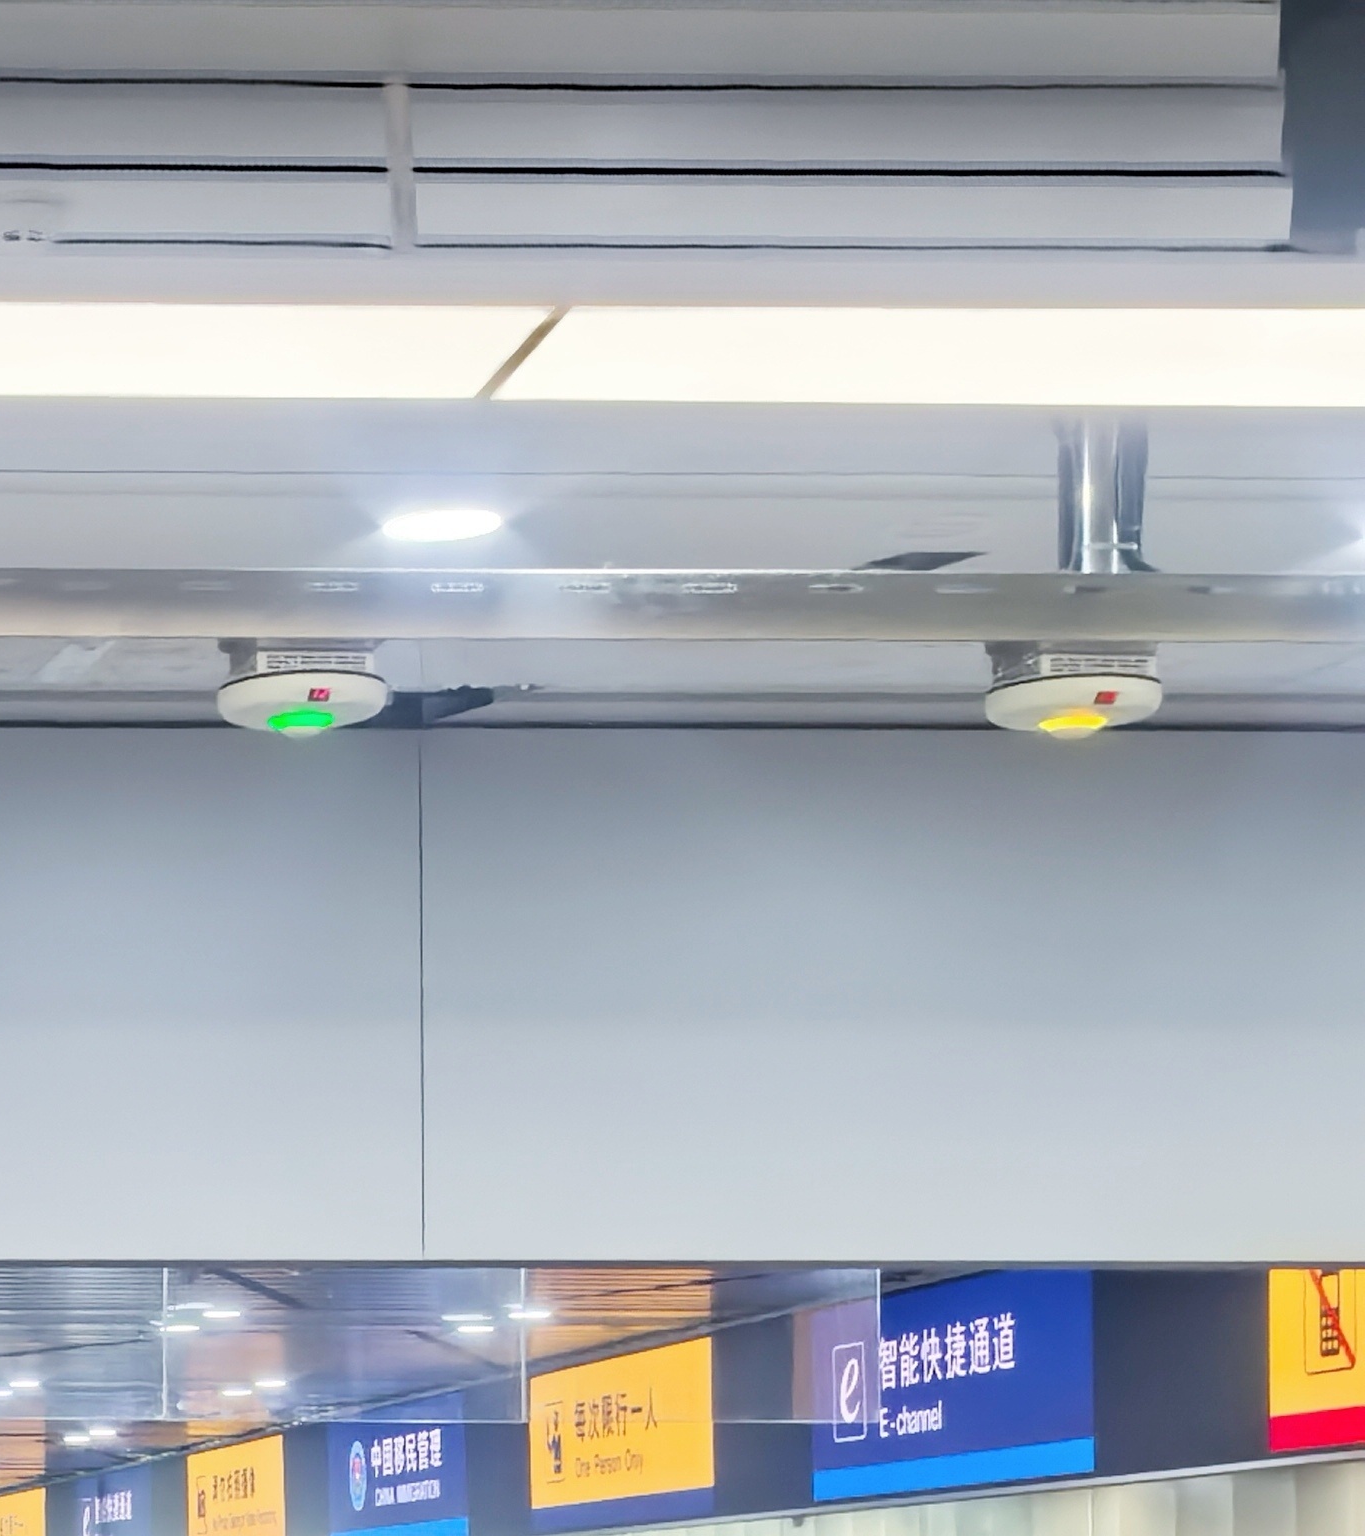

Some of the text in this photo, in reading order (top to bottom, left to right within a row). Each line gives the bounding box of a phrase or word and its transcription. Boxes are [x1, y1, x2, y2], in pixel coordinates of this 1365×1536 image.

[879, 1312, 1016, 1391] 智能快捷通道
[575, 1387, 658, 1442] 每次限行一人
[370, 1428, 443, 1478] 中国移民管理
[575, 1457, 591, 1478] One
[594, 1453, 621, 1475] Person
